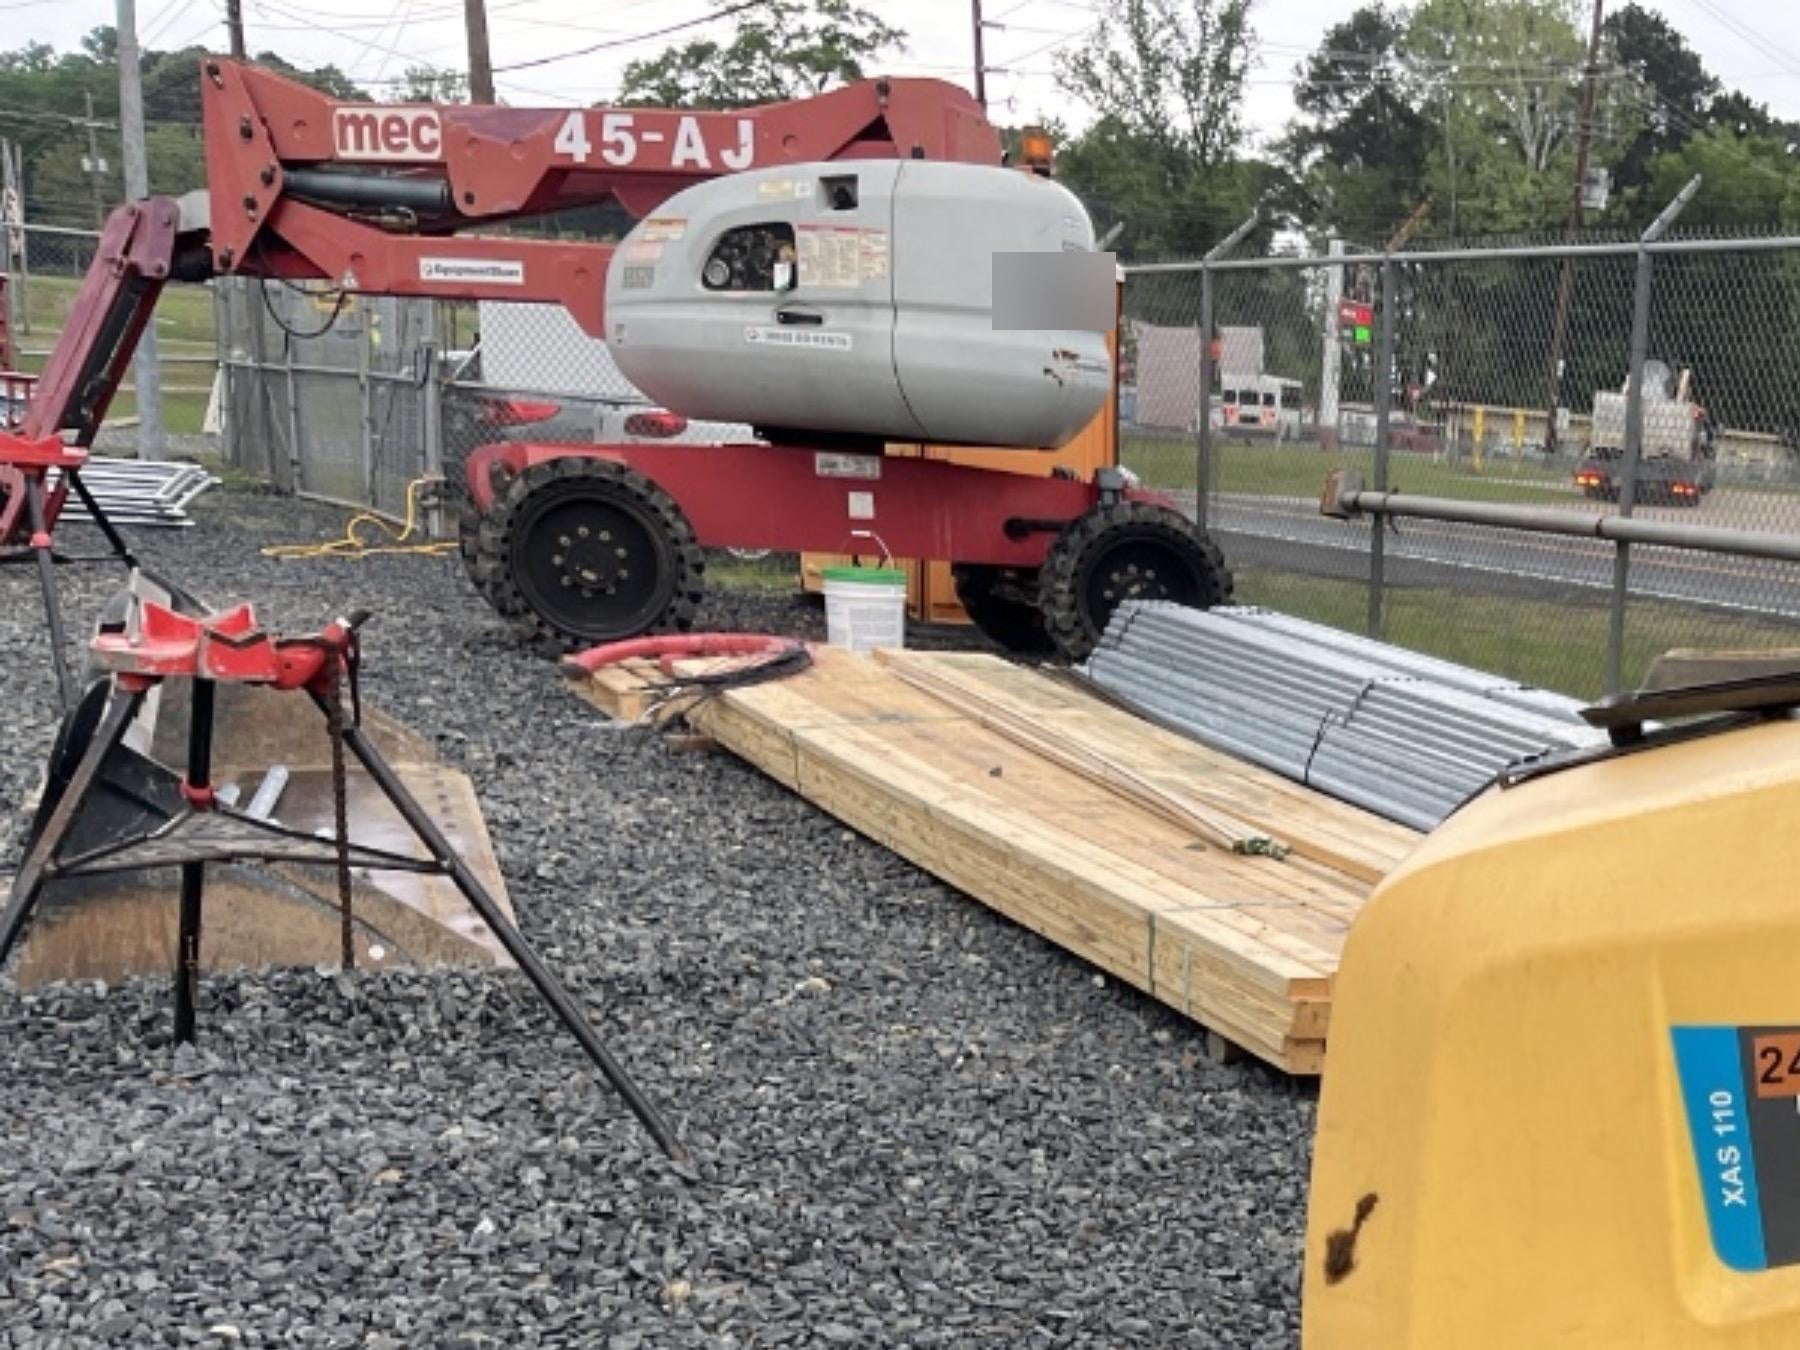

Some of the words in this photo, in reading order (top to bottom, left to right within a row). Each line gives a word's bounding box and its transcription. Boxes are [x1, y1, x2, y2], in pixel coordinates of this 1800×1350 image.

[336, 112, 440, 154] mec
[1709, 1091, 1735, 1136] 110
[1718, 1146, 1746, 1207] XAS
